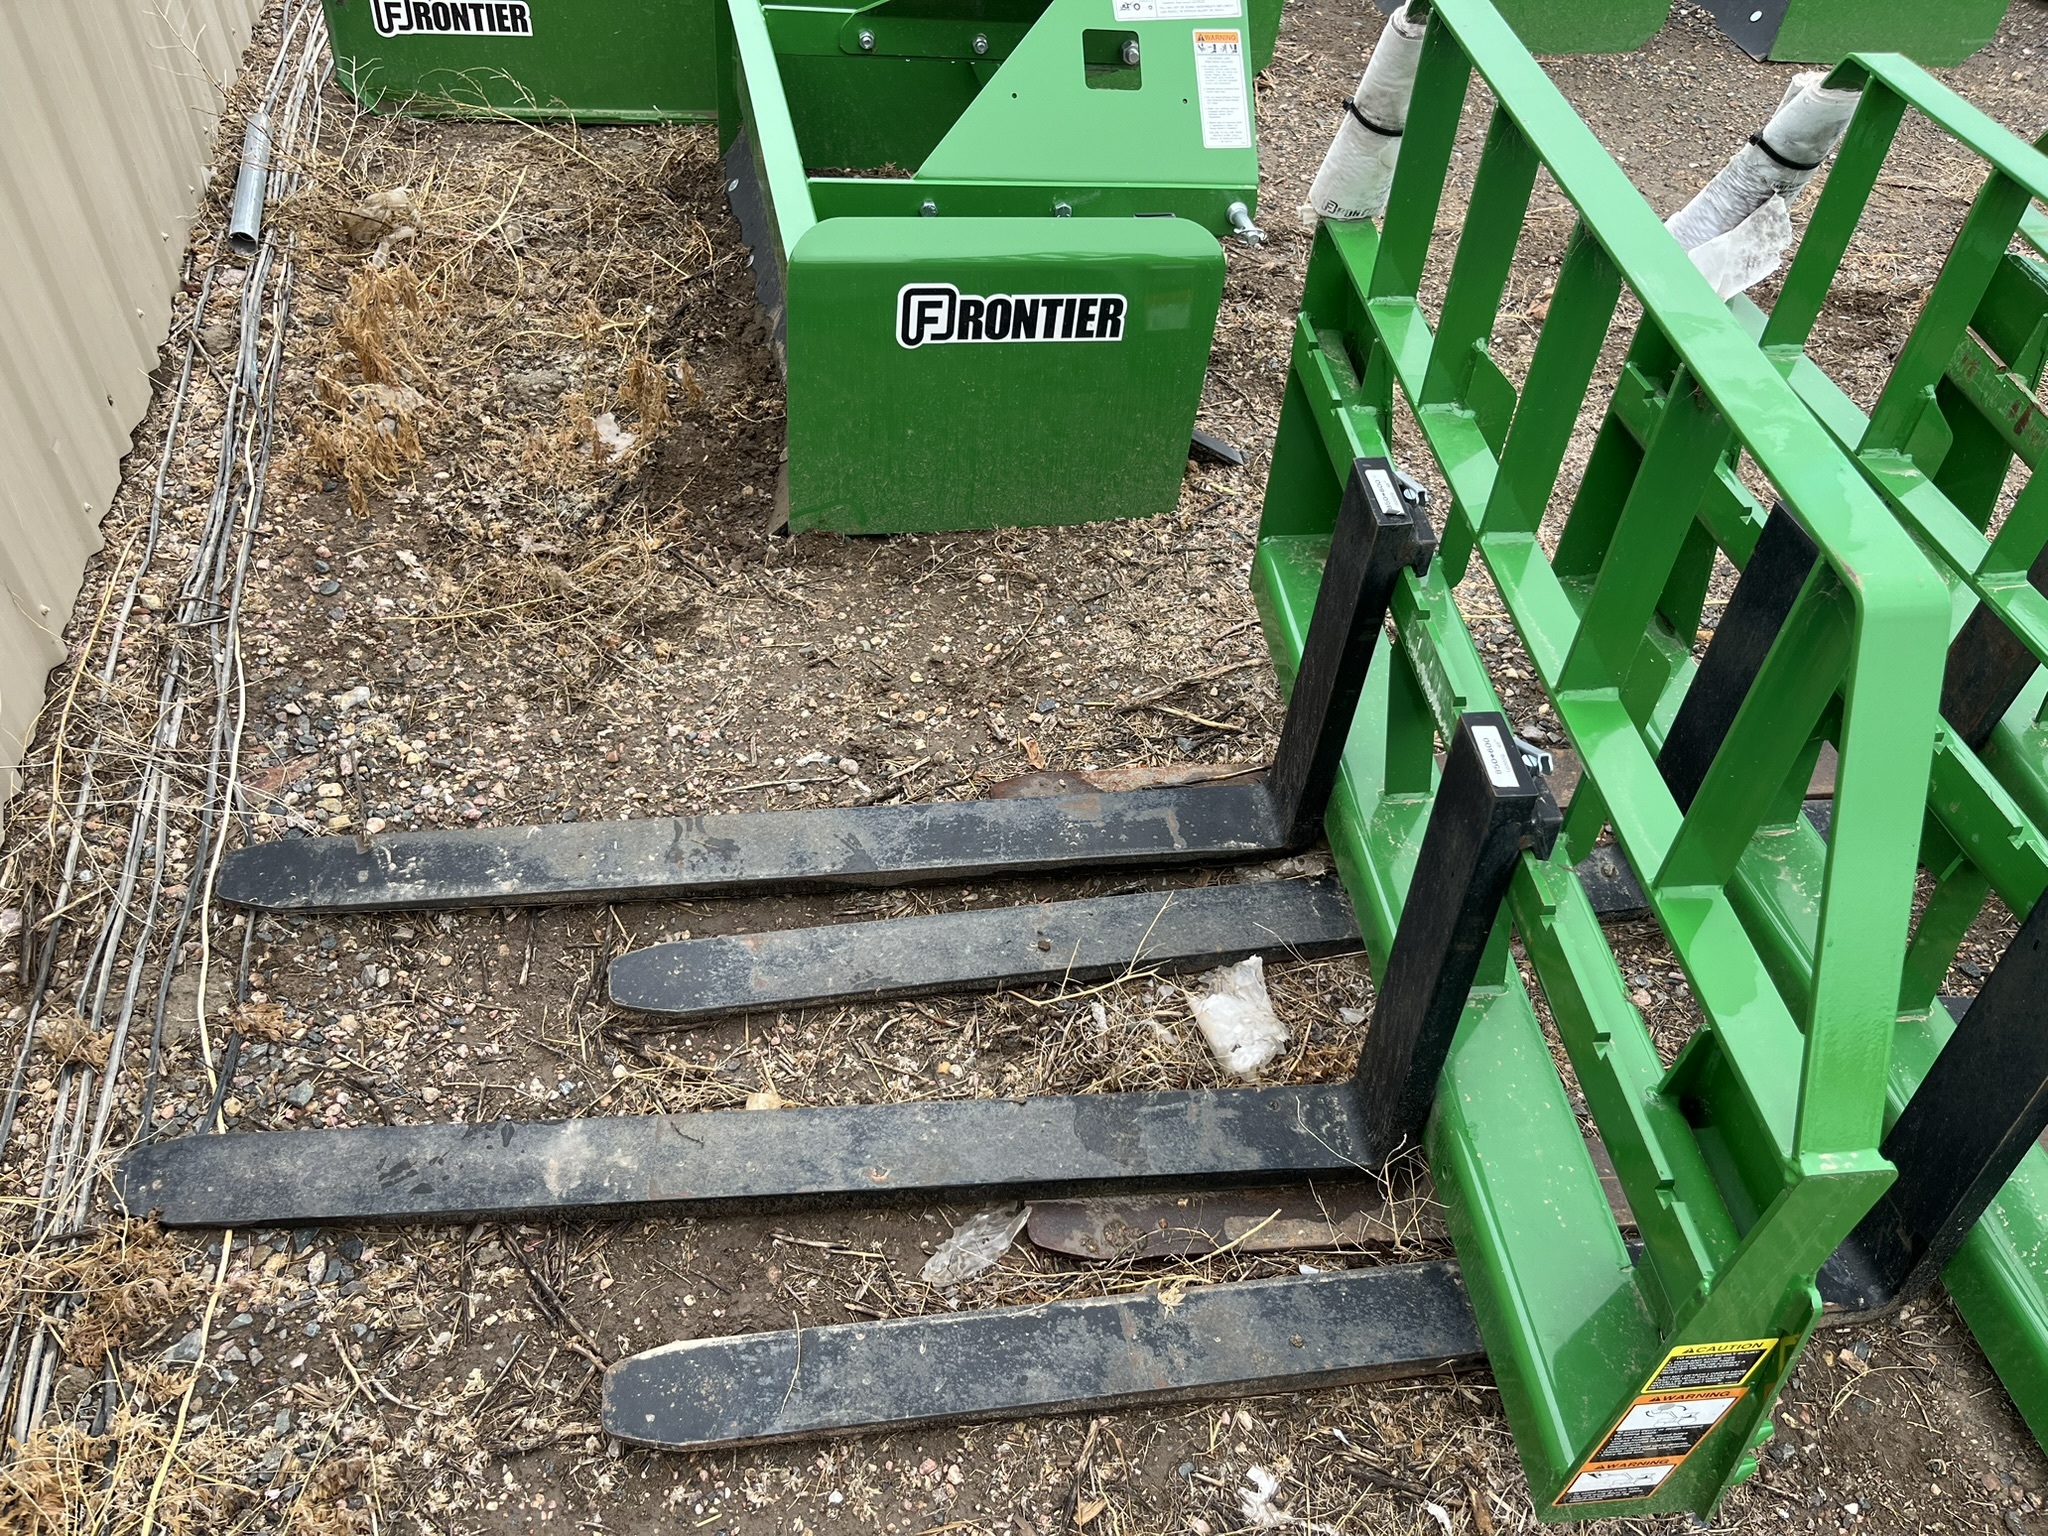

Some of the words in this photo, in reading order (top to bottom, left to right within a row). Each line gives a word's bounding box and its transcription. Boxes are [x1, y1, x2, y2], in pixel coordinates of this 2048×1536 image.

[373, 0, 529, 33] FRONTIER
[901, 287, 1124, 346] FRONTIER
[1696, 1342, 1764, 1353] CAUTION
[1664, 1391, 1731, 1401] WARNING
[1605, 1458, 1670, 1469] WARNING
